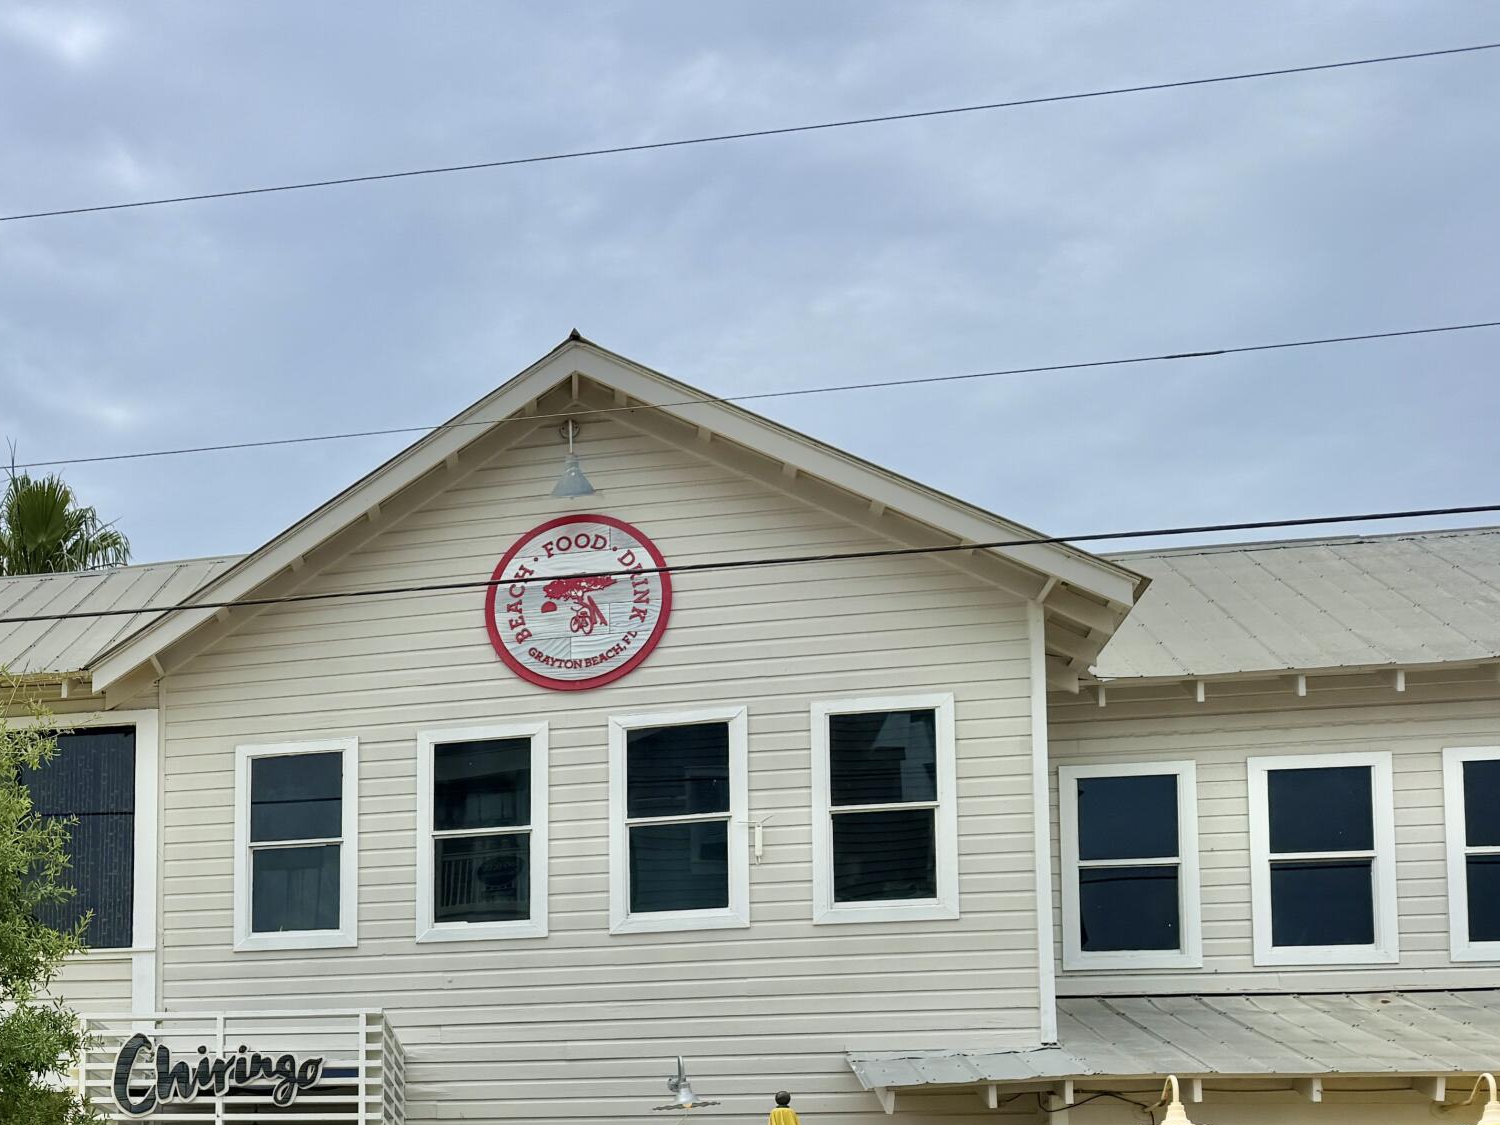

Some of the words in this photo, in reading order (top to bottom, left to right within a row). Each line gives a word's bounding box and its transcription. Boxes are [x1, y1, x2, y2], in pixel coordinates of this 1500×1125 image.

[506, 564, 535, 644] BEACH
[542, 533, 608, 558] FOOD
[617, 550, 650, 623] DRINK
[527, 647, 583, 669] GRAYTON
[585, 643, 627, 668] BEACH,
[621, 631, 638, 646] FL
[112, 1032, 324, 1117] Chiringo
